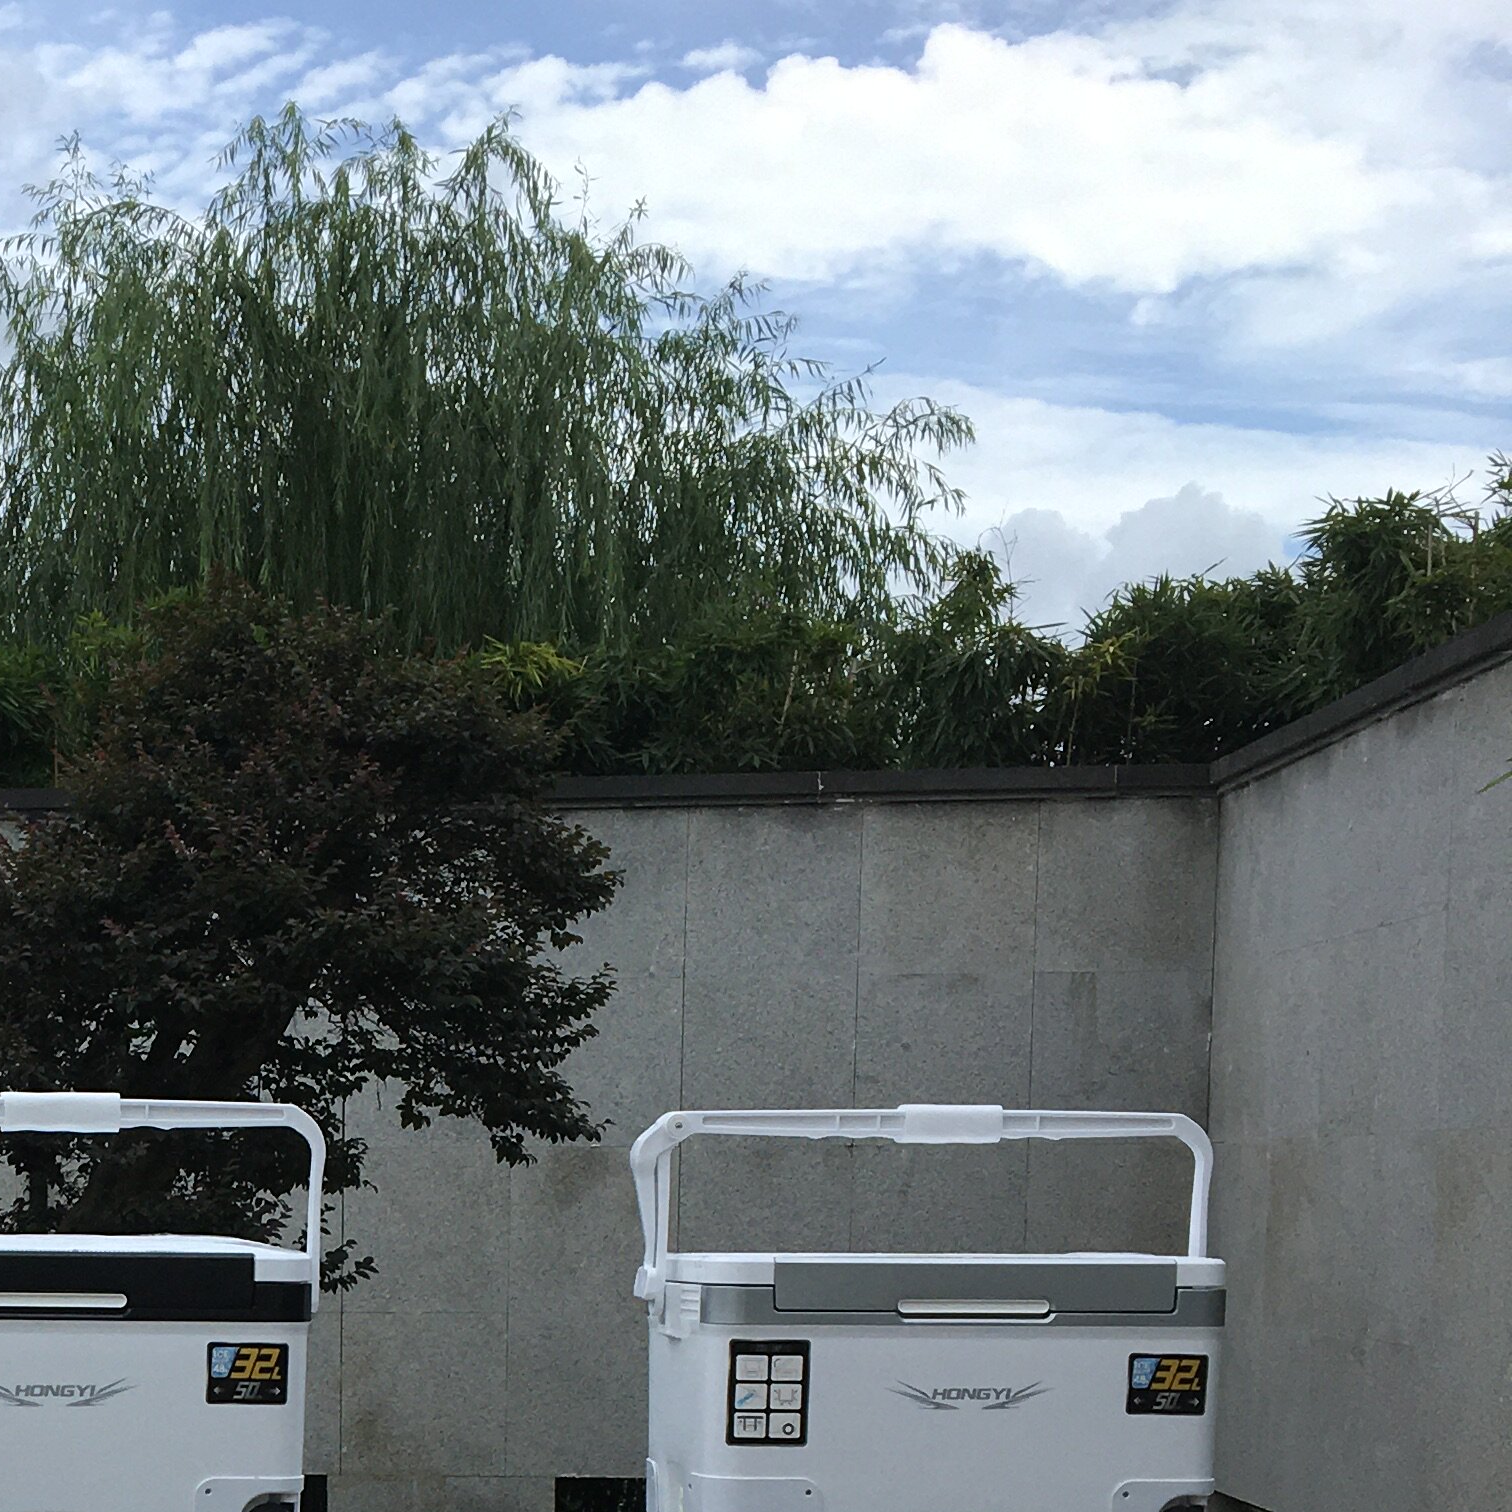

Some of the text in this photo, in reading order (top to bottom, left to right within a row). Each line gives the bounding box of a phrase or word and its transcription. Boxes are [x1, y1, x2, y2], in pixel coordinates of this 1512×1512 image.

[230, 1347, 281, 1379] 32L
[1150, 1359, 1201, 1390] 32L
[15, 1385, 95, 1397] HONGYI
[930, 1388, 1012, 1400] HONGYI
